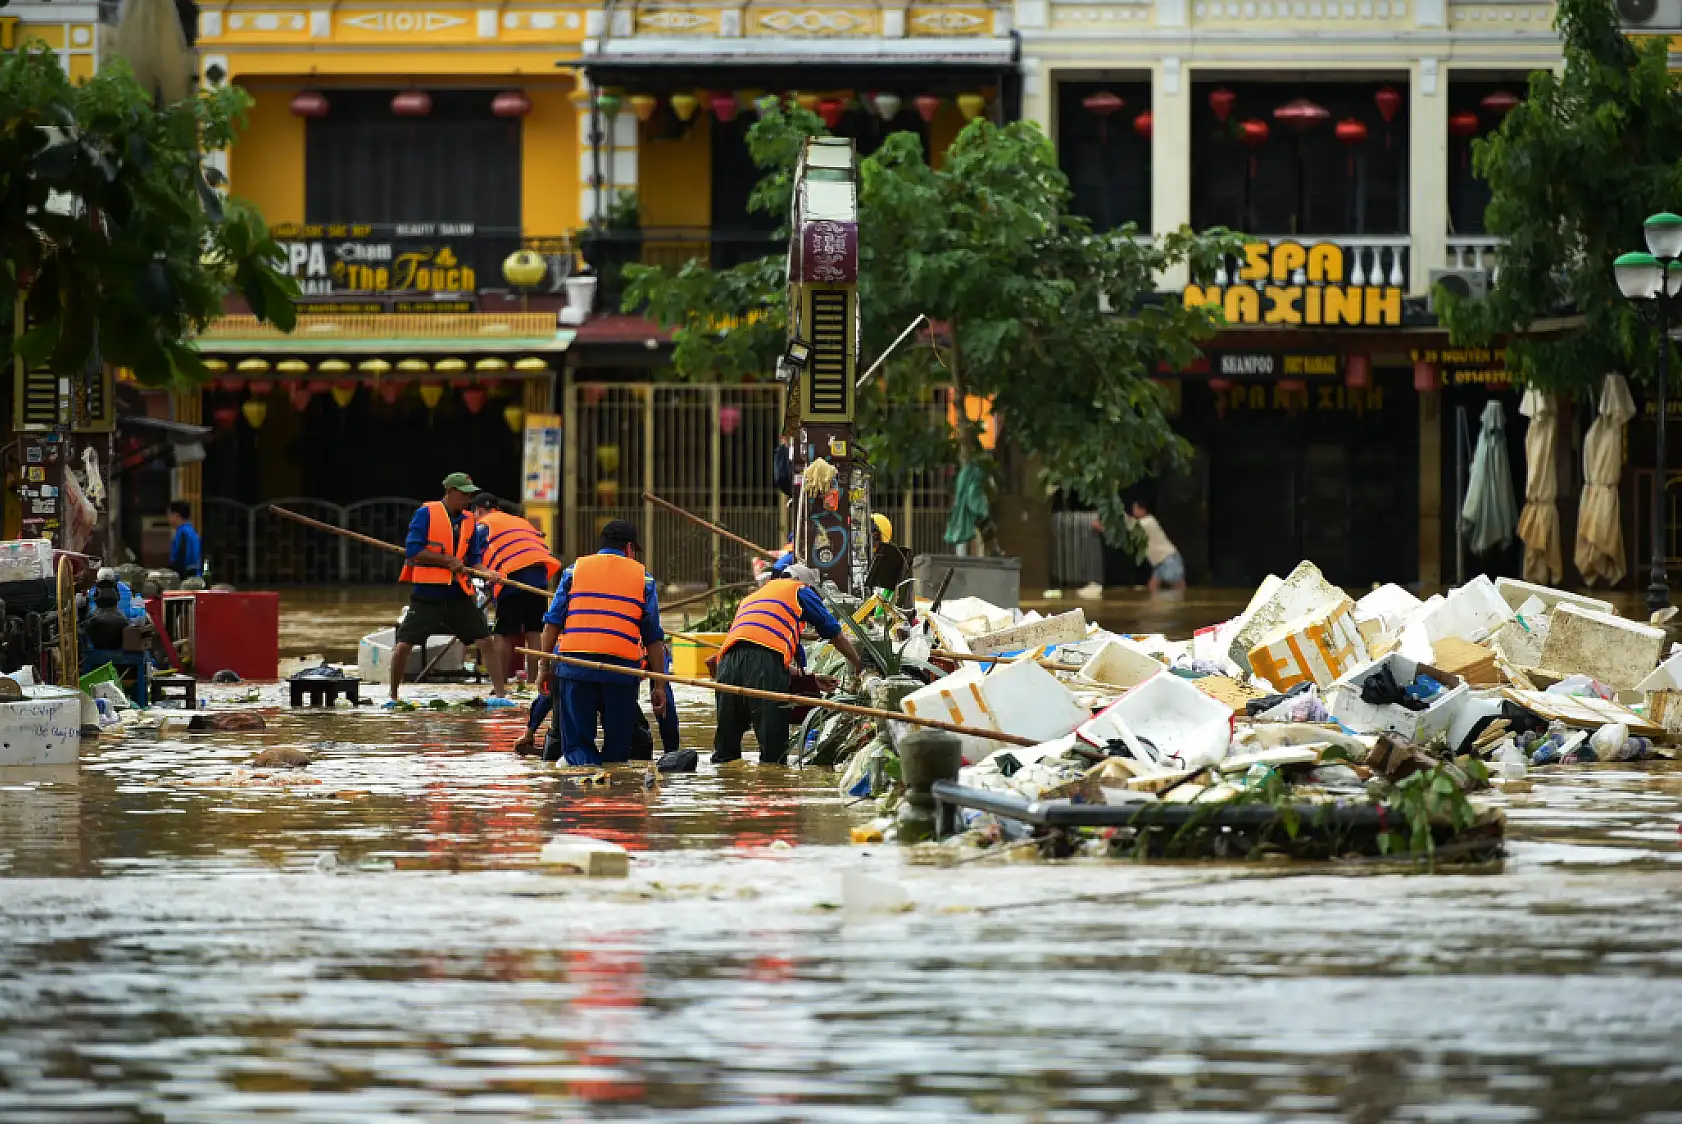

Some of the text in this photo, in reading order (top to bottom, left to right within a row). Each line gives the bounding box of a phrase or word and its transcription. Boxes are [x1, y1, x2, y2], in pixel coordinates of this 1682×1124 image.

[396, 223, 475, 237] BEAUTY SALON
[347, 249, 476, 291] The Touch
[1238, 242, 1345, 282] SPA
[1221, 354, 1275, 375] SHAMPOO
